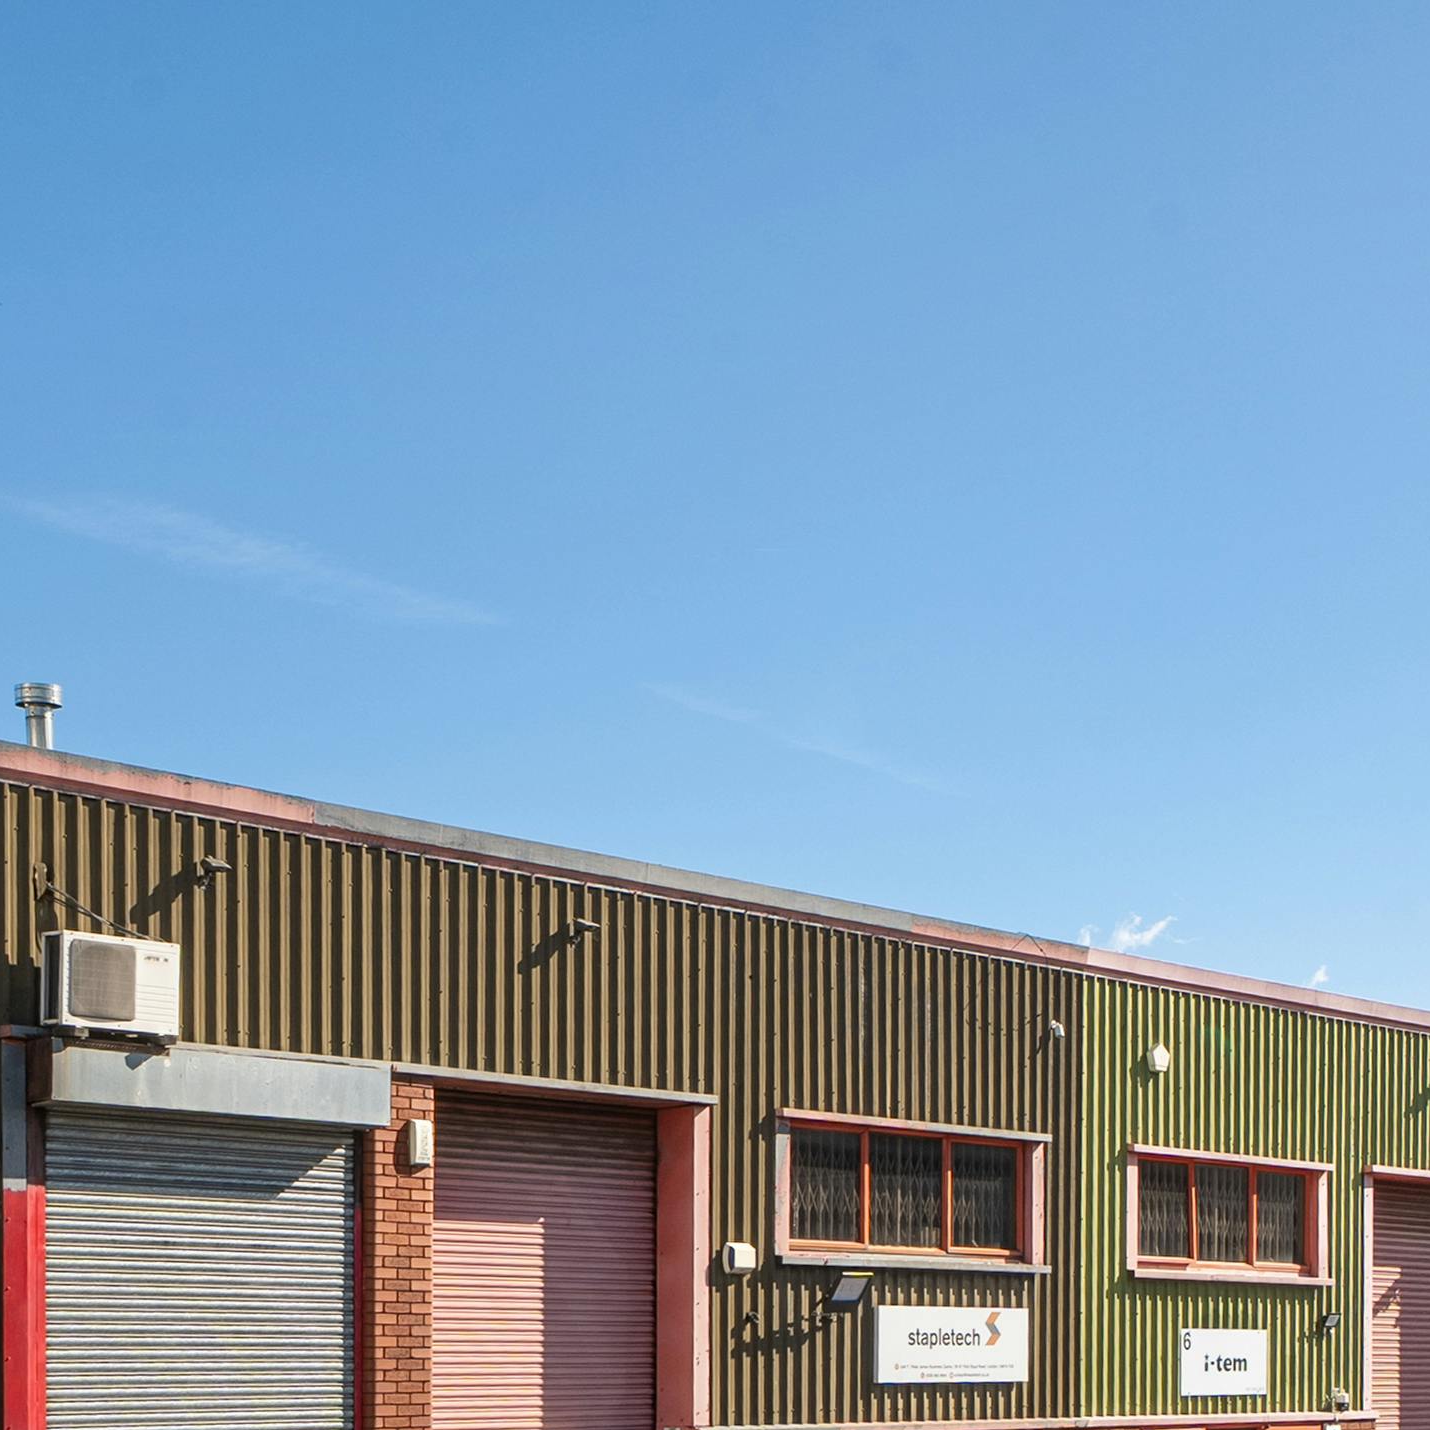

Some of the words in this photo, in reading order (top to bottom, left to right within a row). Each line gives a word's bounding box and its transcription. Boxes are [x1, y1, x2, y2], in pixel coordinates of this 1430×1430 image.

[908, 1328, 981, 1349] stapletech
[1183, 1332, 1191, 1350] 6
[1204, 1354, 1248, 1372] i-tem
